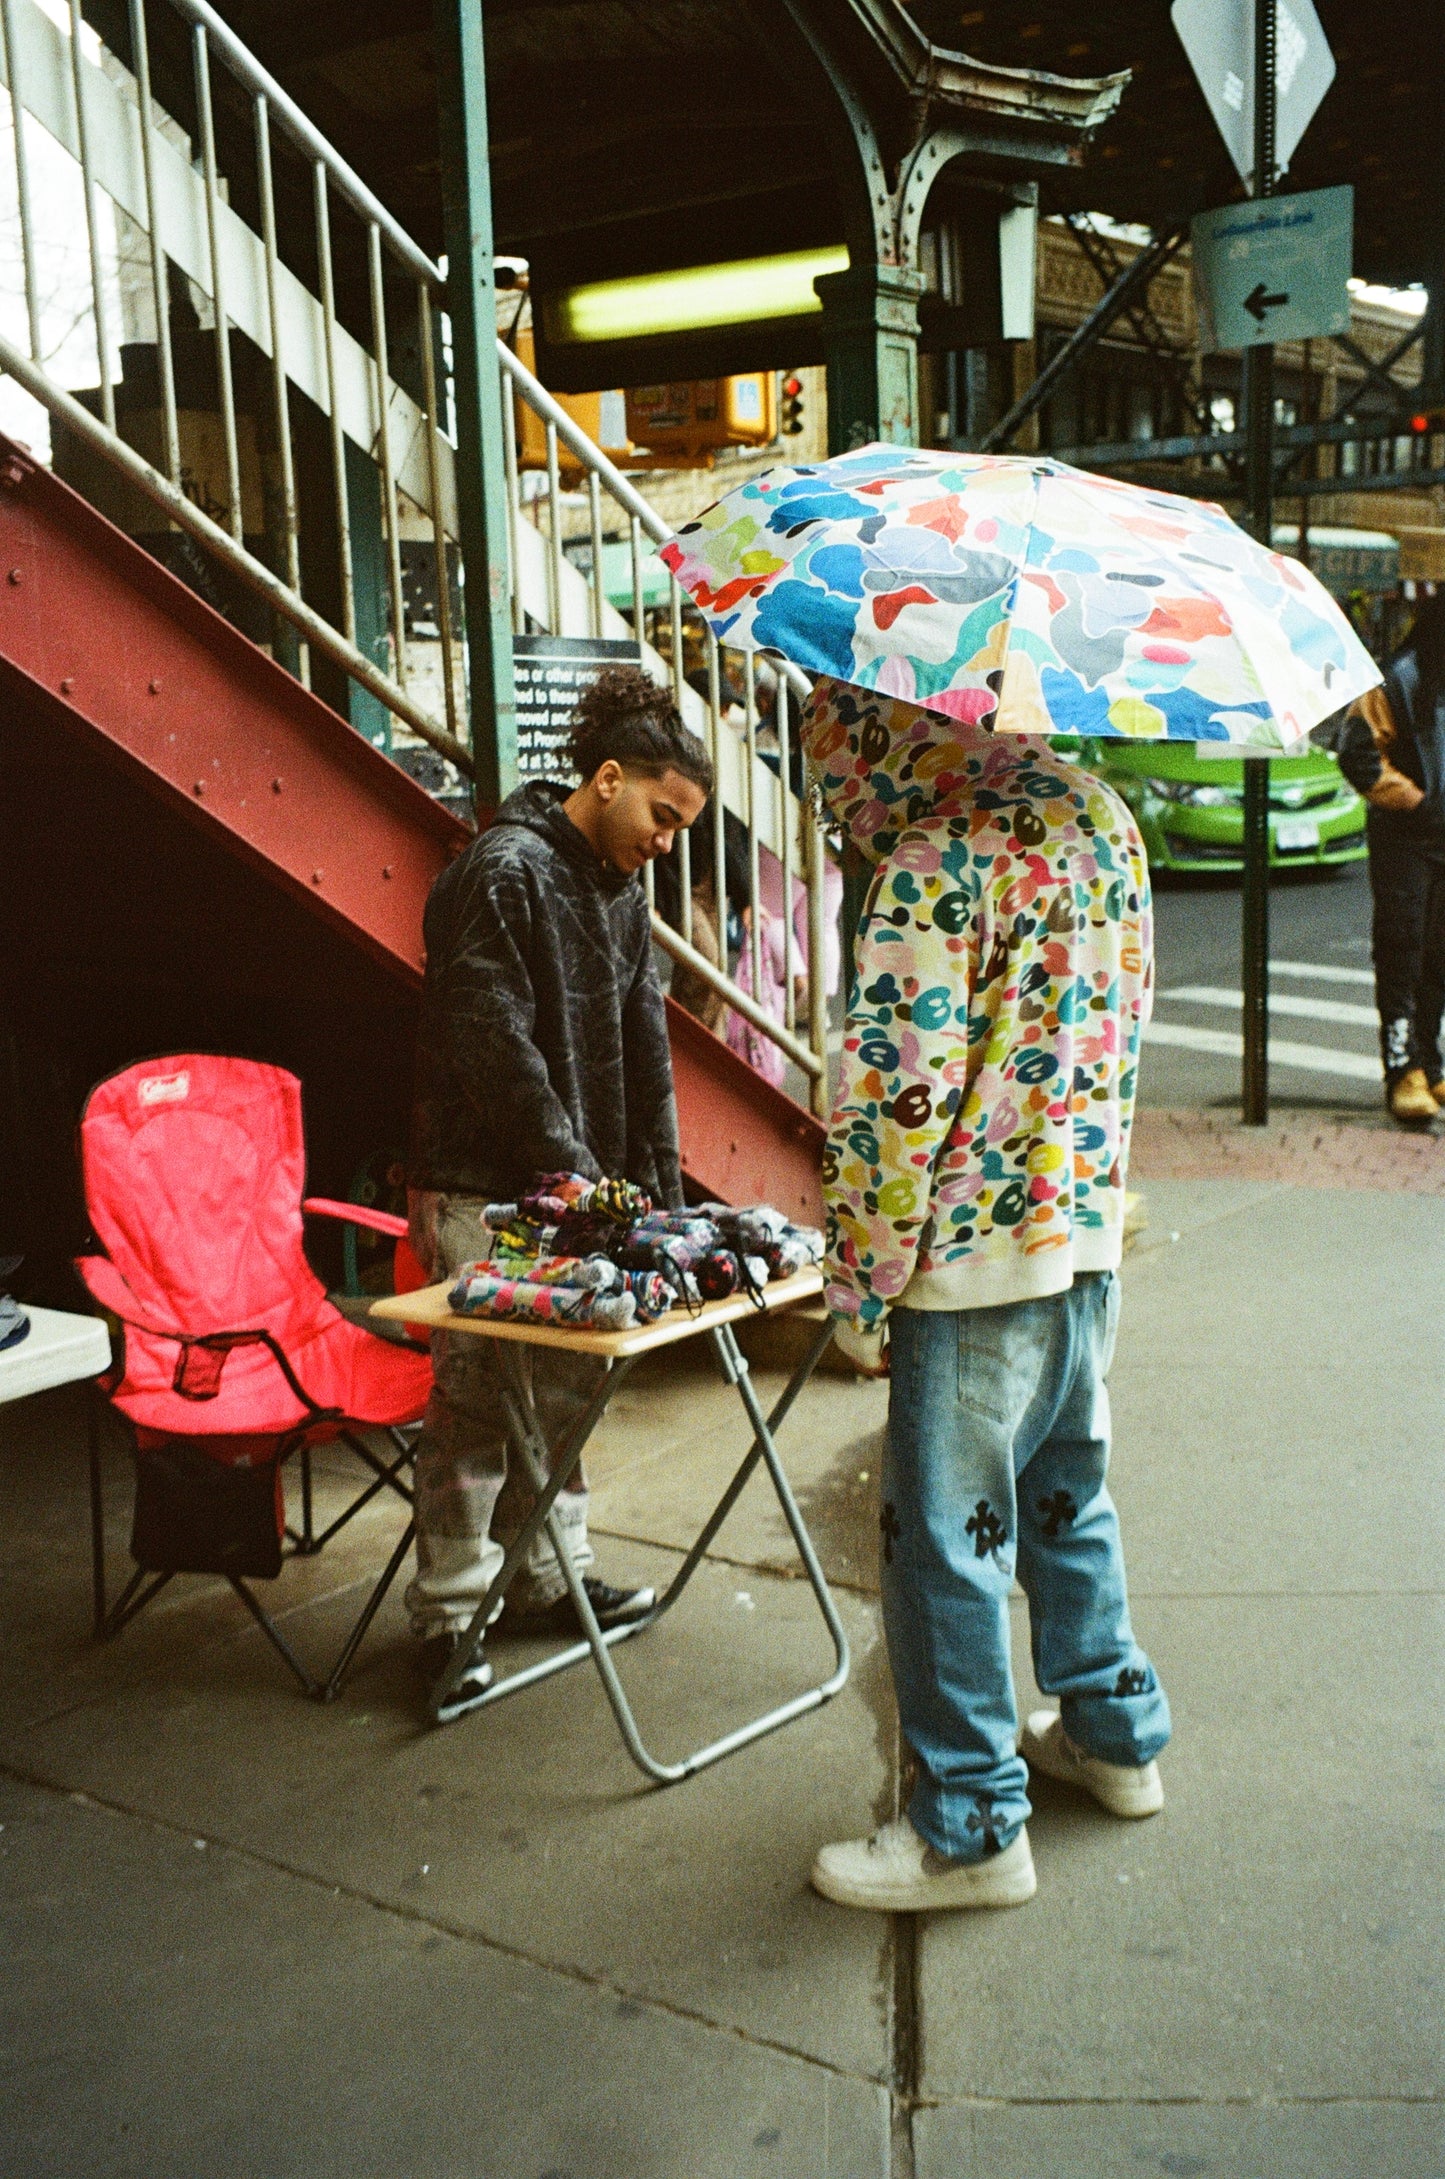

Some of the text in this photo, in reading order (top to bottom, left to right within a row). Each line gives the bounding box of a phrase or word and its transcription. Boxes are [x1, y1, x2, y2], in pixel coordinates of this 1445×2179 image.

[531, 669, 543, 683] or
[546, 667, 573, 683] other
[535, 688, 547, 704] to
[549, 688, 579, 705] these
